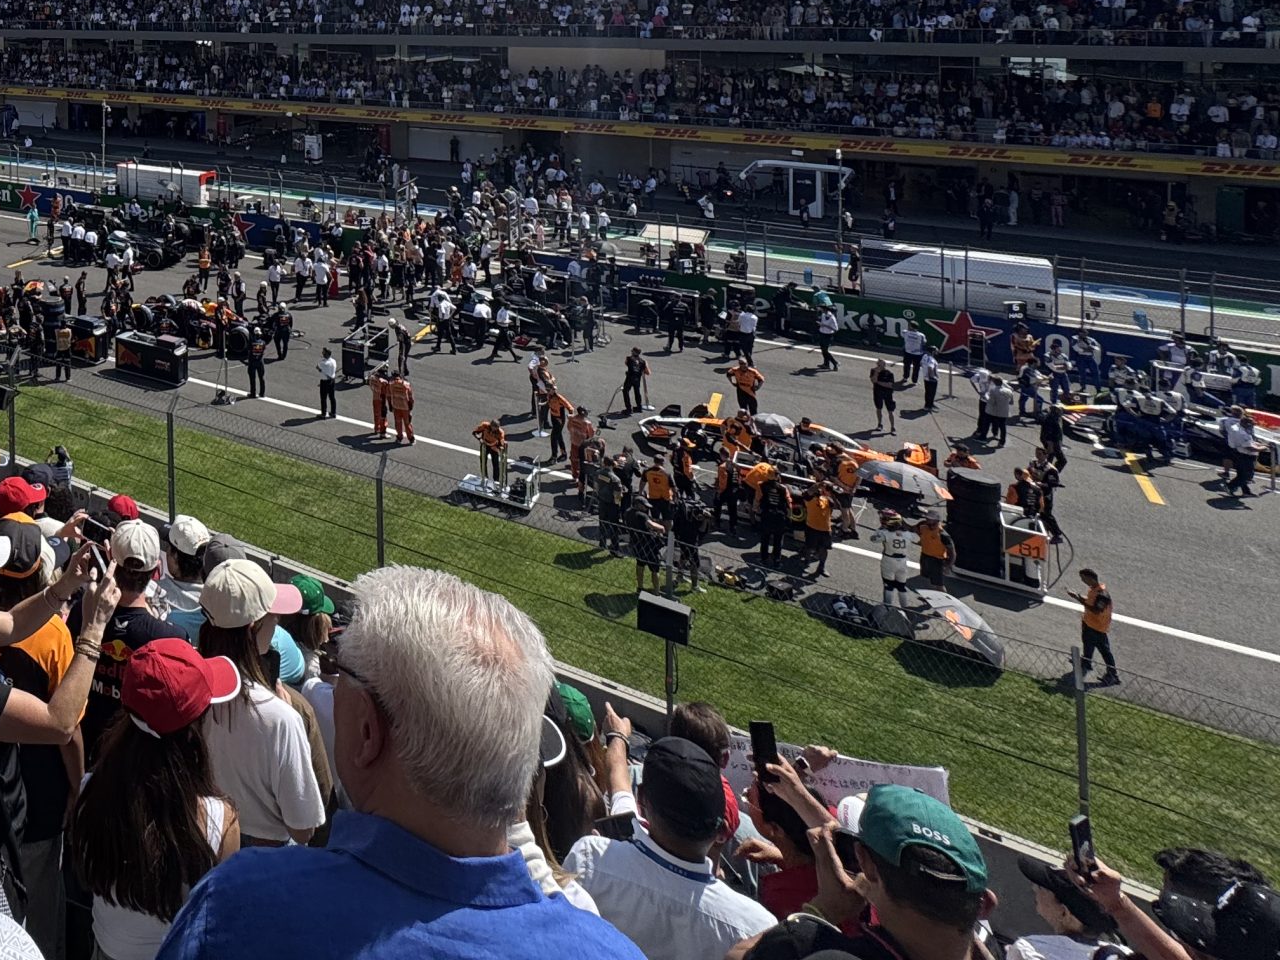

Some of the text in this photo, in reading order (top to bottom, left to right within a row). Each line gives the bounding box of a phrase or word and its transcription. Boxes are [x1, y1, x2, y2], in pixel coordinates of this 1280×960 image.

[152, 96, 178, 104] DHL
[200, 99, 227, 107] DHL
[252, 102, 281, 110] DHL
[306, 105, 338, 115] DHL
[366, 109, 400, 119] DHL
[430, 113, 467, 123] DHL
[499, 117, 540, 128] DHL
[573, 122, 618, 133] DHL
[653, 127, 702, 139] DHL
[742, 133, 796, 146] DHL
[840, 139, 898, 153] DHL
[948, 146, 1012, 160] DHL
[1068, 153, 1137, 168] DHL
[1201, 161, 1280, 178] DHL
[892, 539, 906, 549] 81
[92, 679, 121, 699] Mob
[911, 822, 951, 846] BOSS
